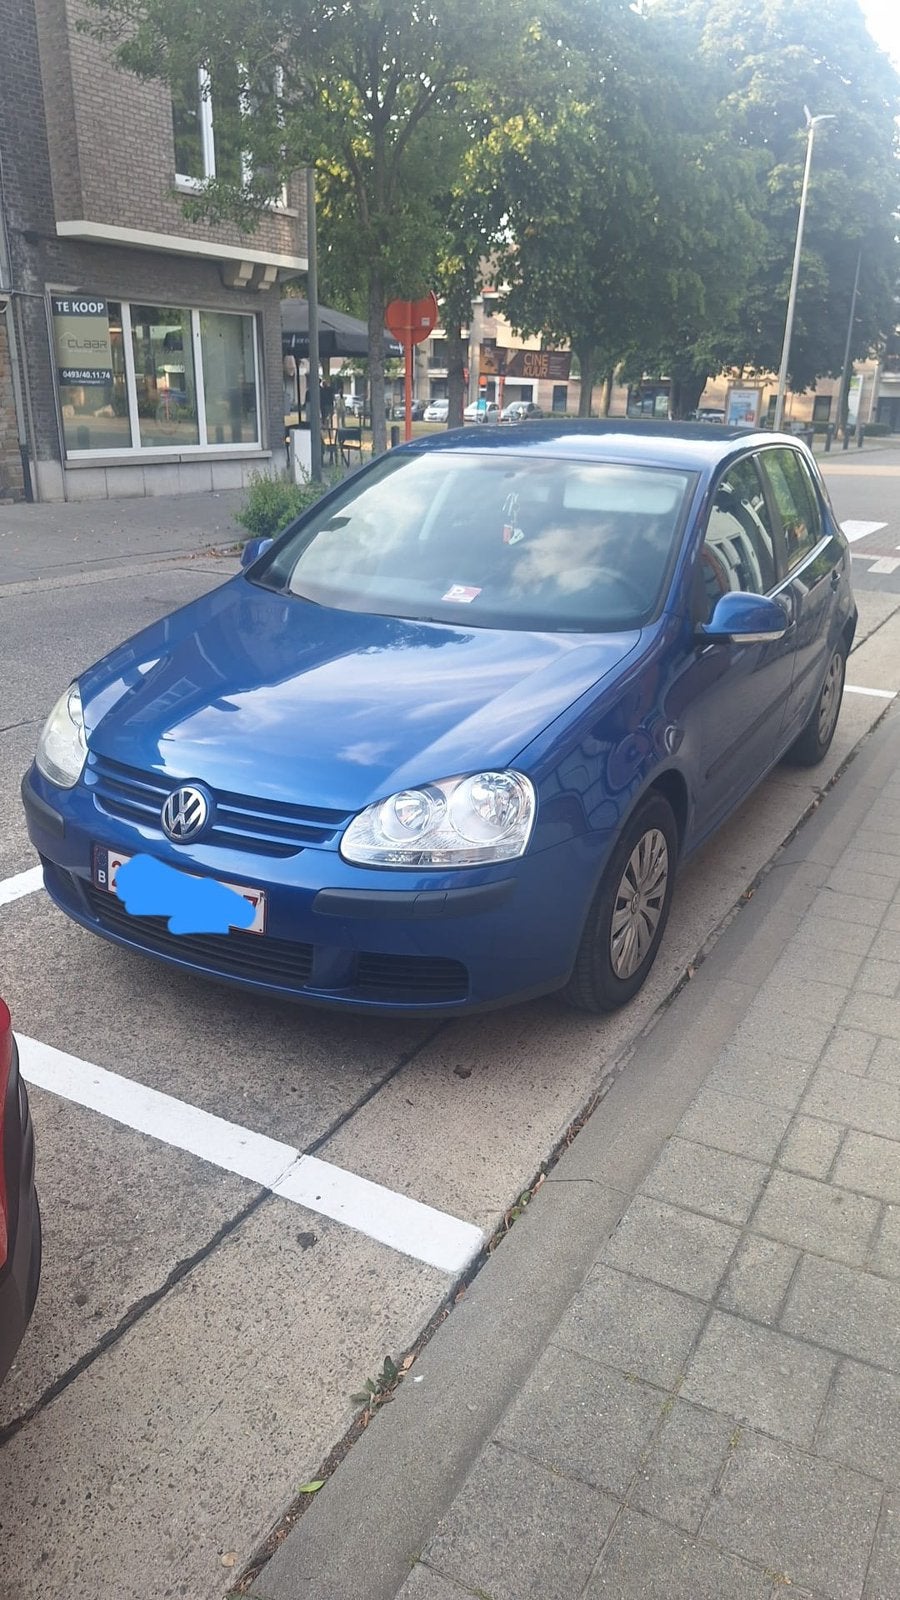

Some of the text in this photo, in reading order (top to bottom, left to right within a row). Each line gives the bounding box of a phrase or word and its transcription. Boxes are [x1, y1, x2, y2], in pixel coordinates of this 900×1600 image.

[56, 302, 104, 313] TE KOOP
[523, 366, 547, 376] KUUR
[98, 870, 106, 884] B
